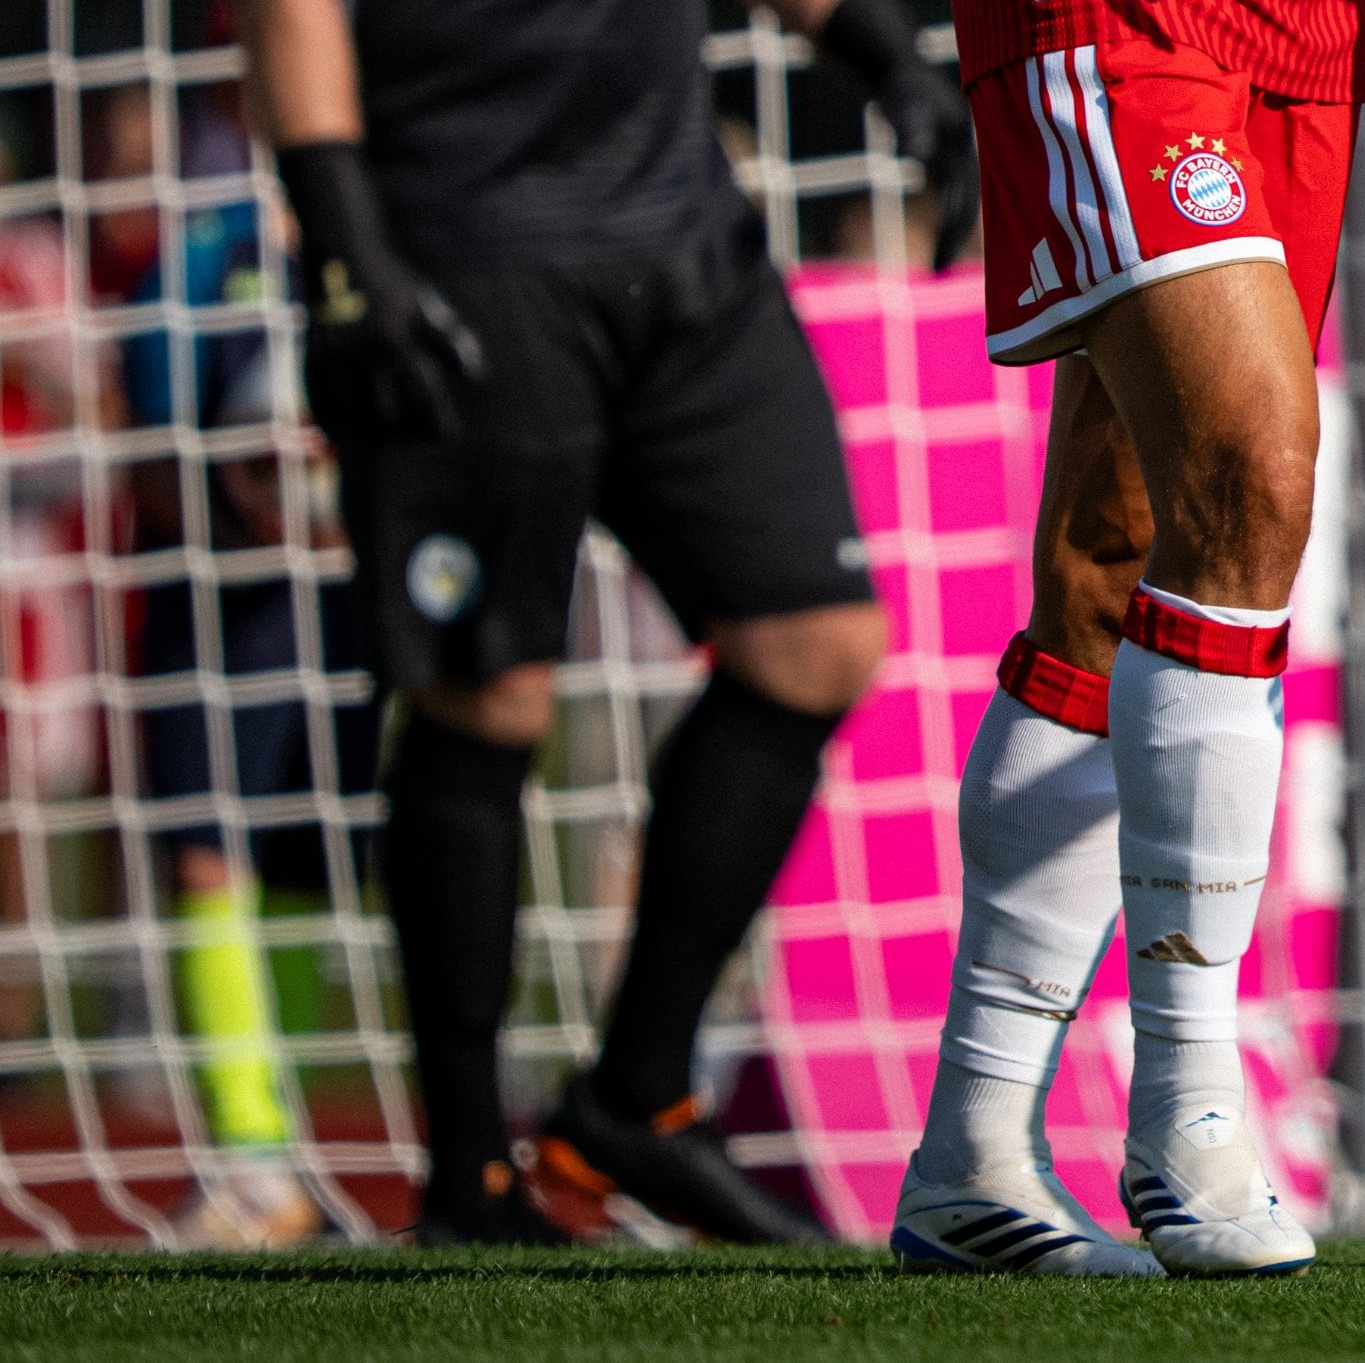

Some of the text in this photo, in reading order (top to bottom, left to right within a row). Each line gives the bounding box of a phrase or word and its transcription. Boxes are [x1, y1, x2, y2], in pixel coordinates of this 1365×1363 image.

[1176, 158, 1236, 188] FC BAYERN
[1198, 881, 1236, 894] MIA
[1036, 980, 1071, 997] MIA
